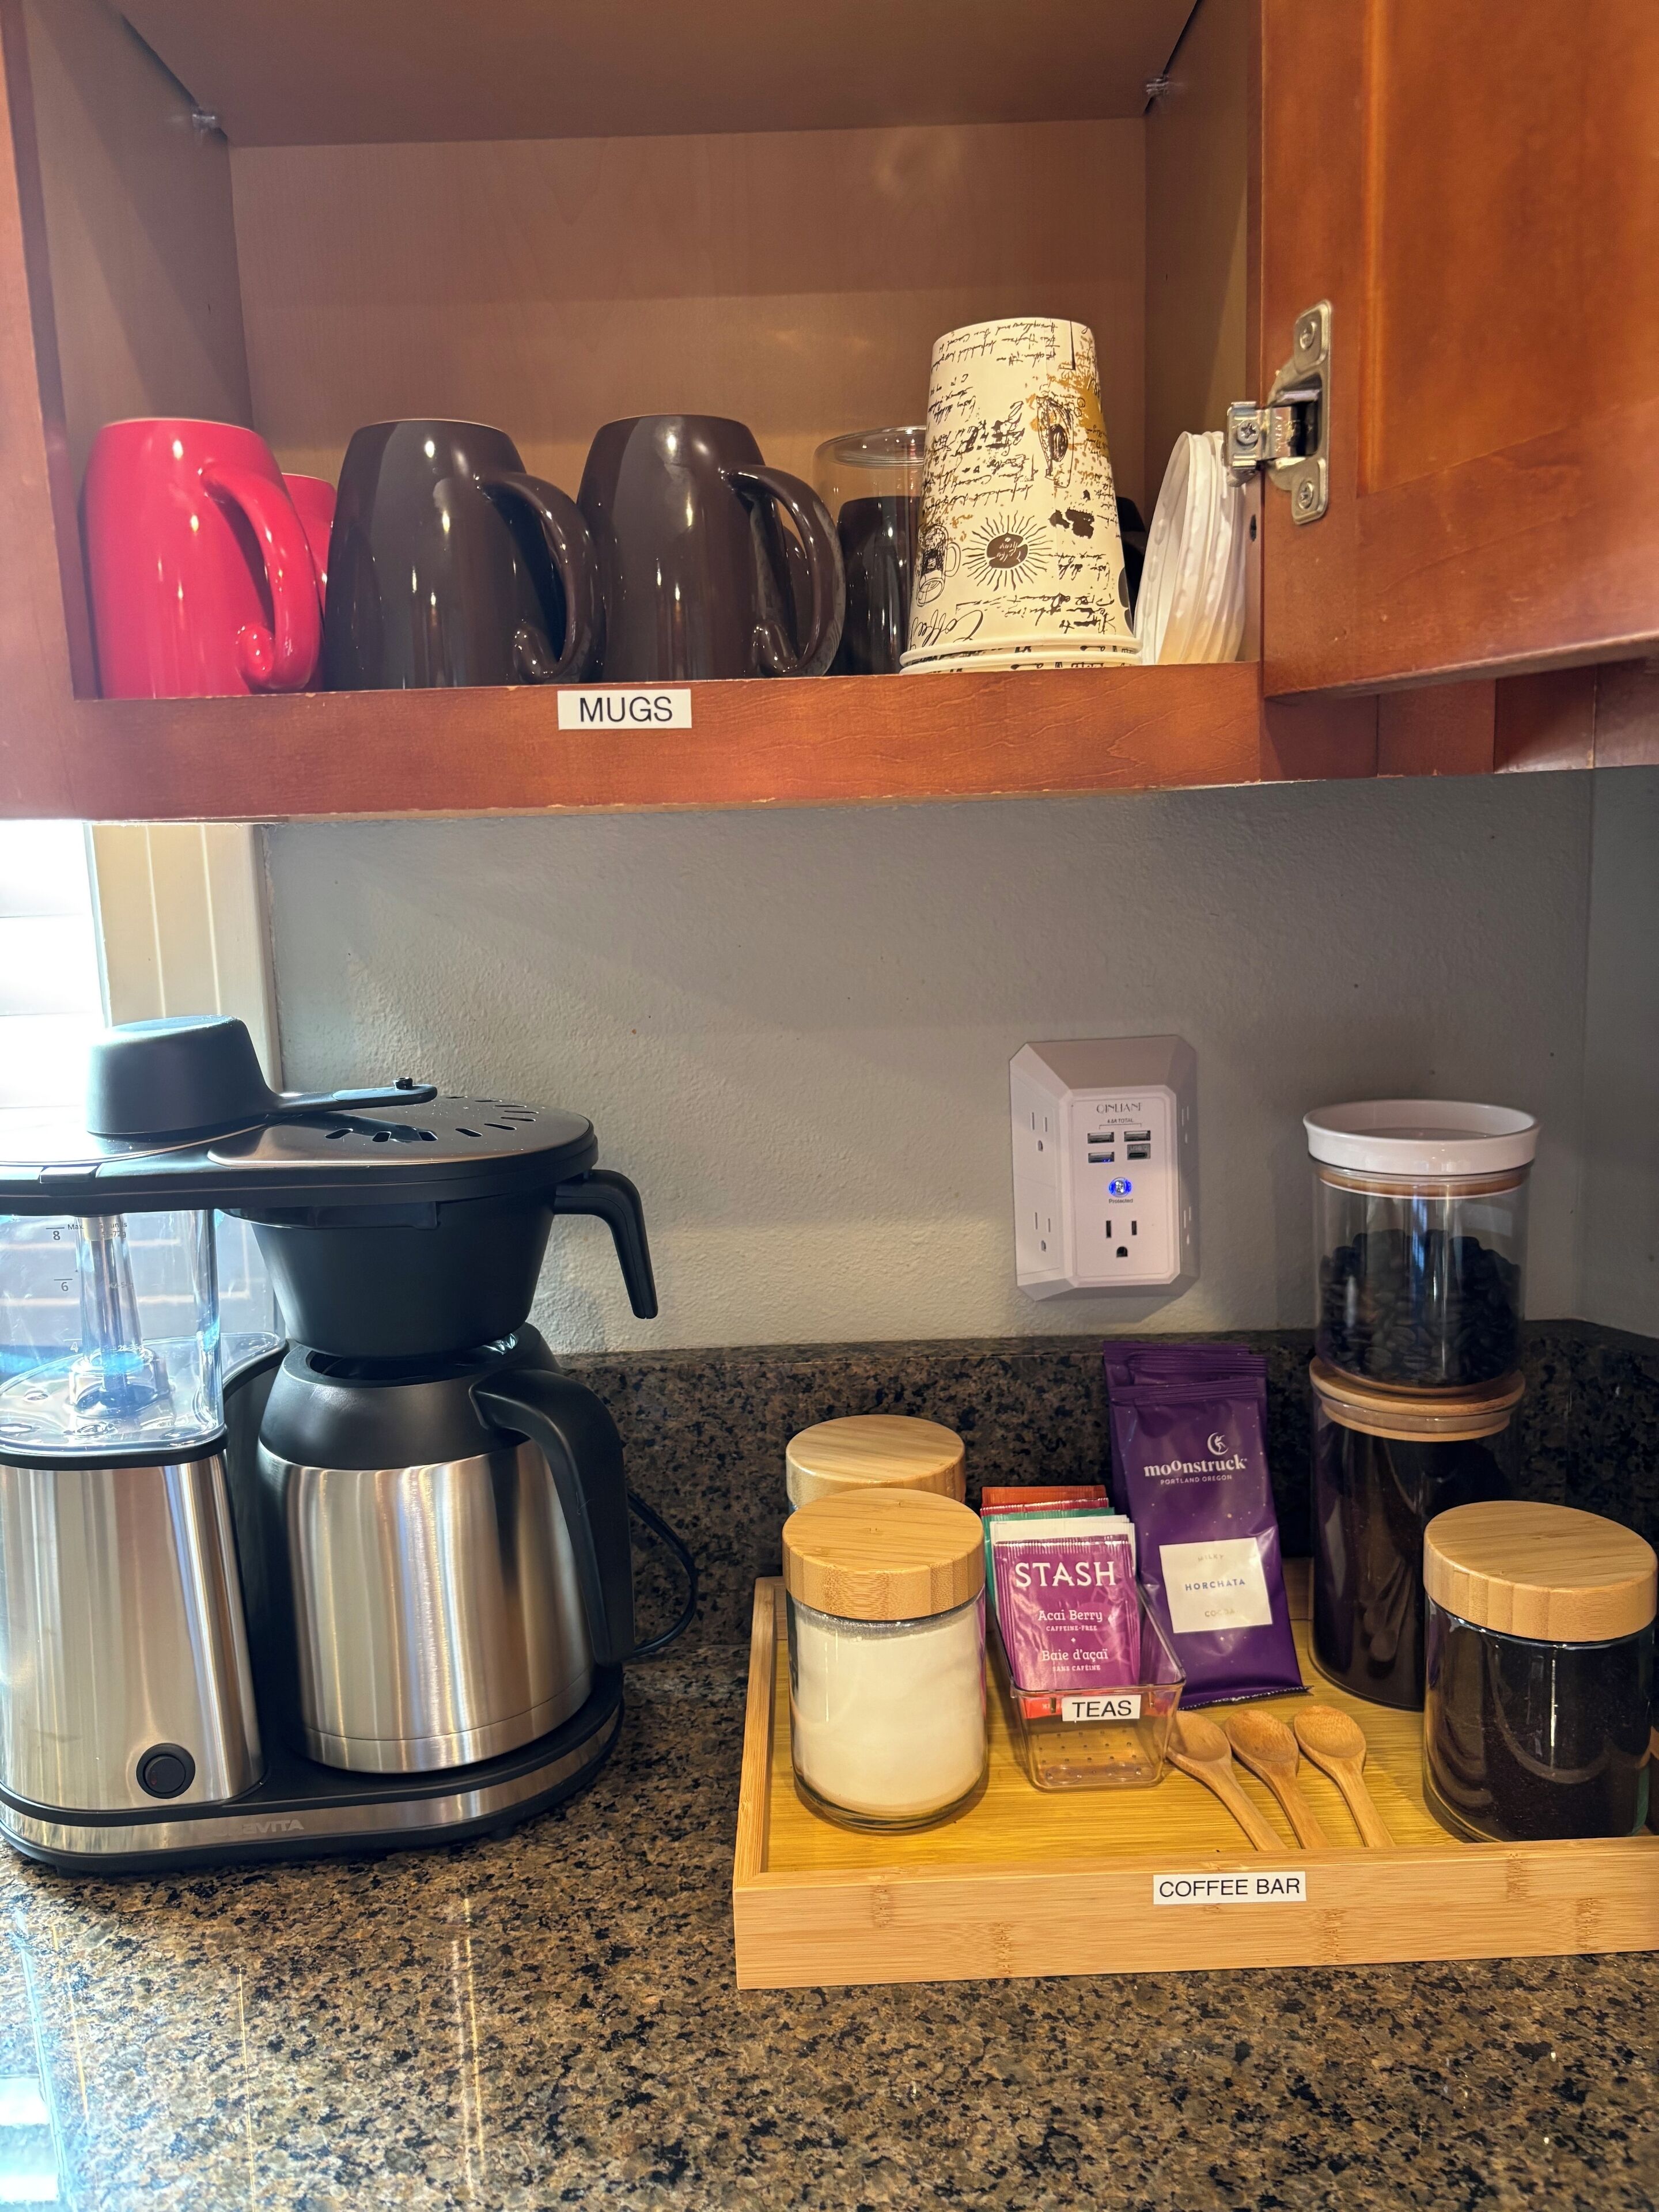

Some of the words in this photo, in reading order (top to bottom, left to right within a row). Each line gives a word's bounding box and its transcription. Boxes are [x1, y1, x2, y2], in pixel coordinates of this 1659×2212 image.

[580, 696, 673, 722] MUGS
[53, 1230, 60, 1241] 8
[61, 1282, 69, 1291] 6
[1160, 1476, 1200, 1485] PORTLAND
[1202, 1474, 1232, 1482] OREGON
[1015, 1561, 1116, 1588] STASH
[1185, 1578, 1245, 1591] HORCHATA
[1037, 1609, 1066, 1621] Acai
[1069, 1609, 1103, 1623] Berry
[1042, 1649, 1069, 1661] Baie
[1072, 1700, 1132, 1718] TEAS
[1159, 1879, 1249, 1897] COFFEE
[1256, 1878, 1300, 1895] BAR
